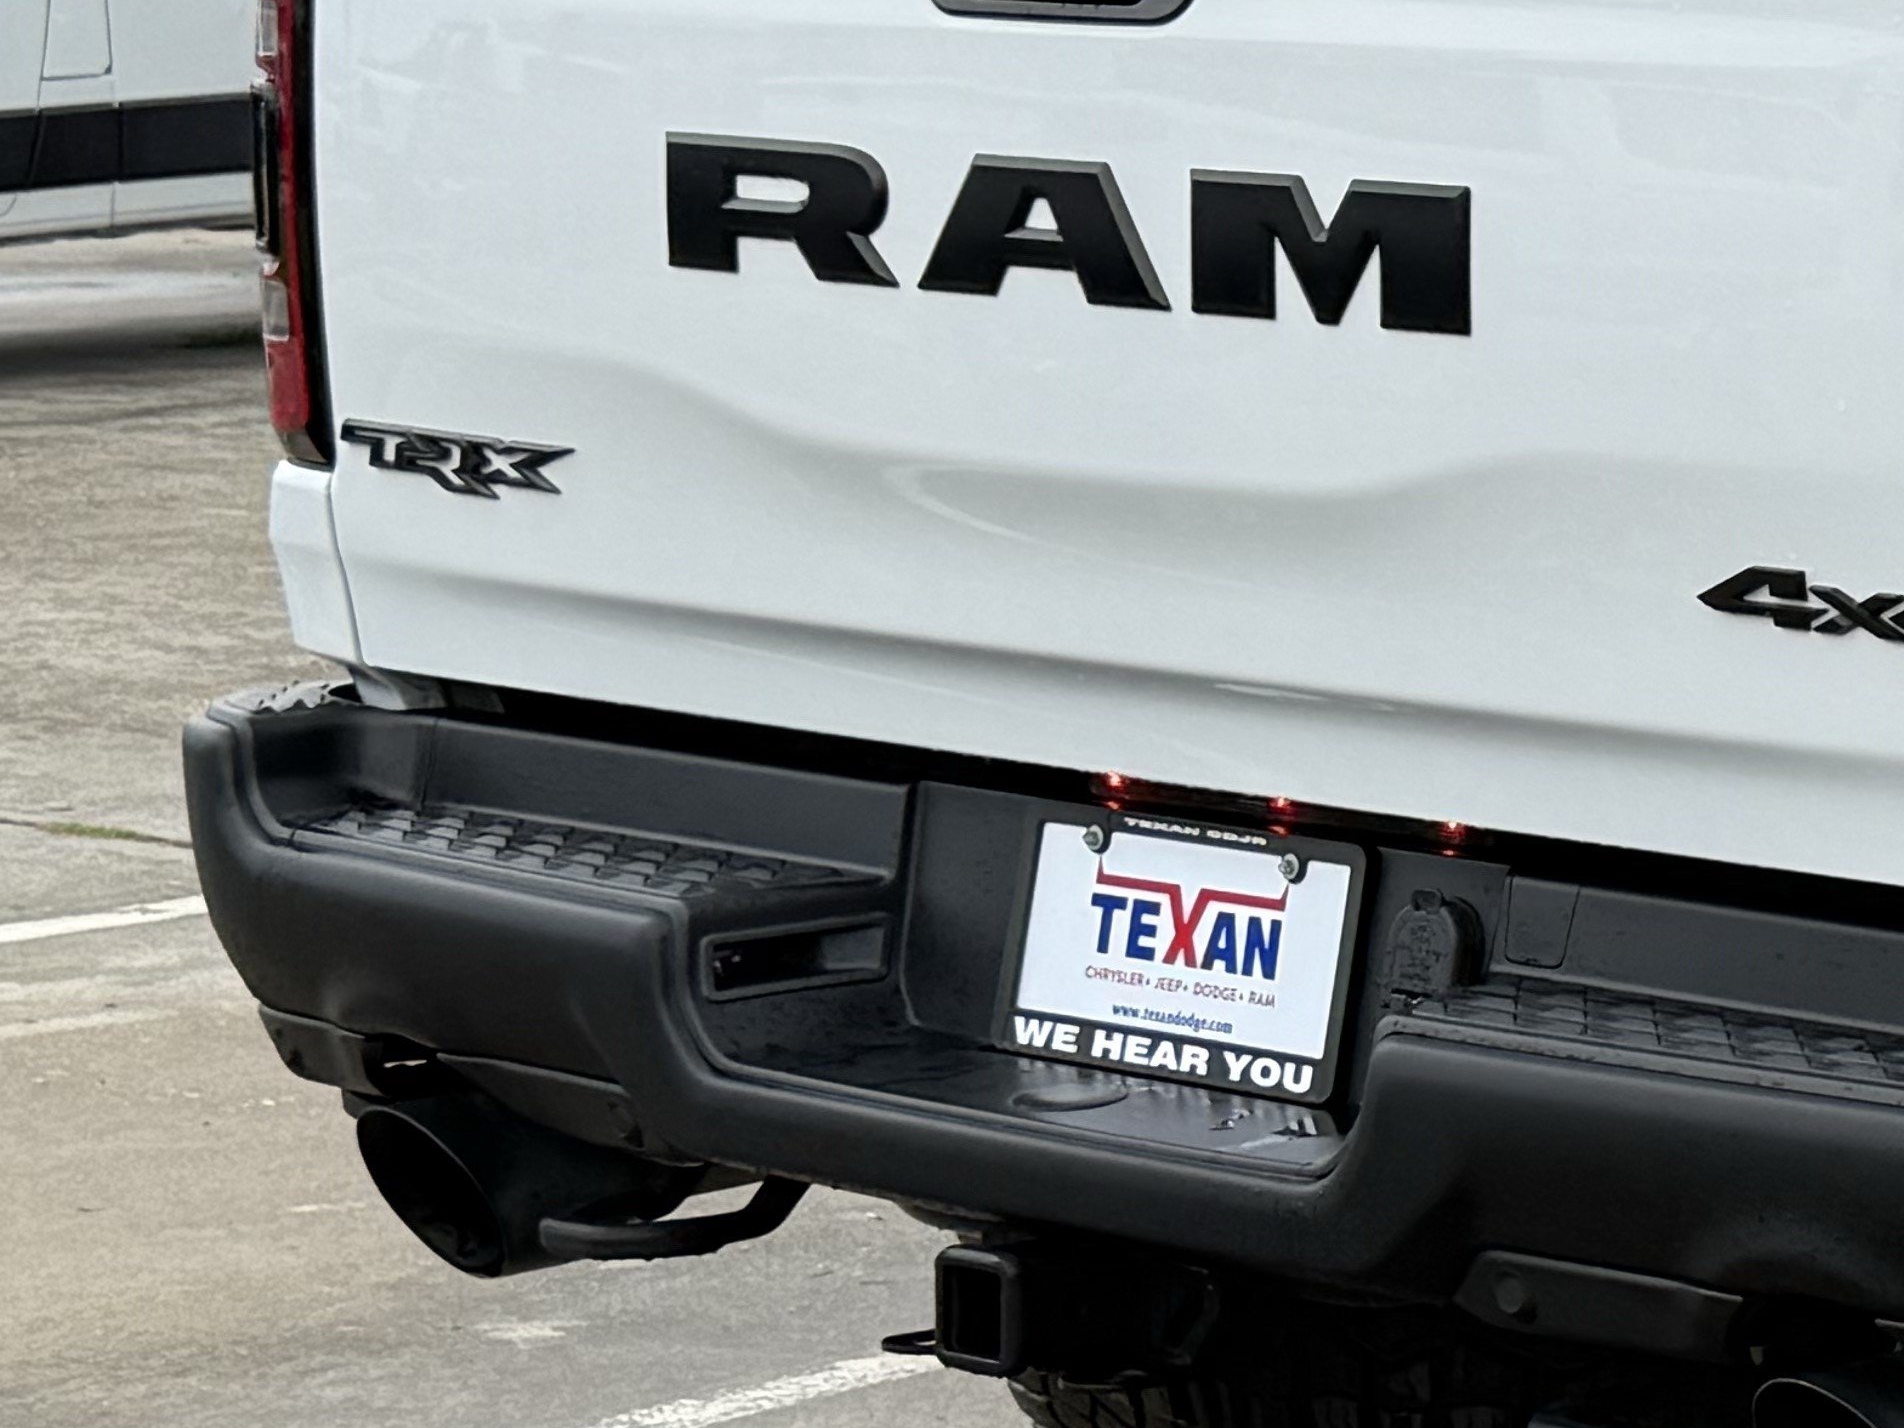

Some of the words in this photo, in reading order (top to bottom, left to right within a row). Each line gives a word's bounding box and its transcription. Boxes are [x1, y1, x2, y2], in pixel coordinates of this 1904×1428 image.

[665, 131, 1473, 335] RAM
[341, 416, 575, 500] TRX
[1124, 816, 1201, 838] TEXAN
[1091, 860, 1289, 980] TEXAN
[1085, 964, 1144, 987] CHRYSLER
[1154, 976, 1183, 993] JEEP
[1193, 981, 1238, 1002] DODGE
[1248, 989, 1276, 1008] RAM
[1013, 1015, 1079, 1054] WE
[1091, 1028, 1210, 1077] HEAR
[1222, 1049, 1314, 1095] YOU
